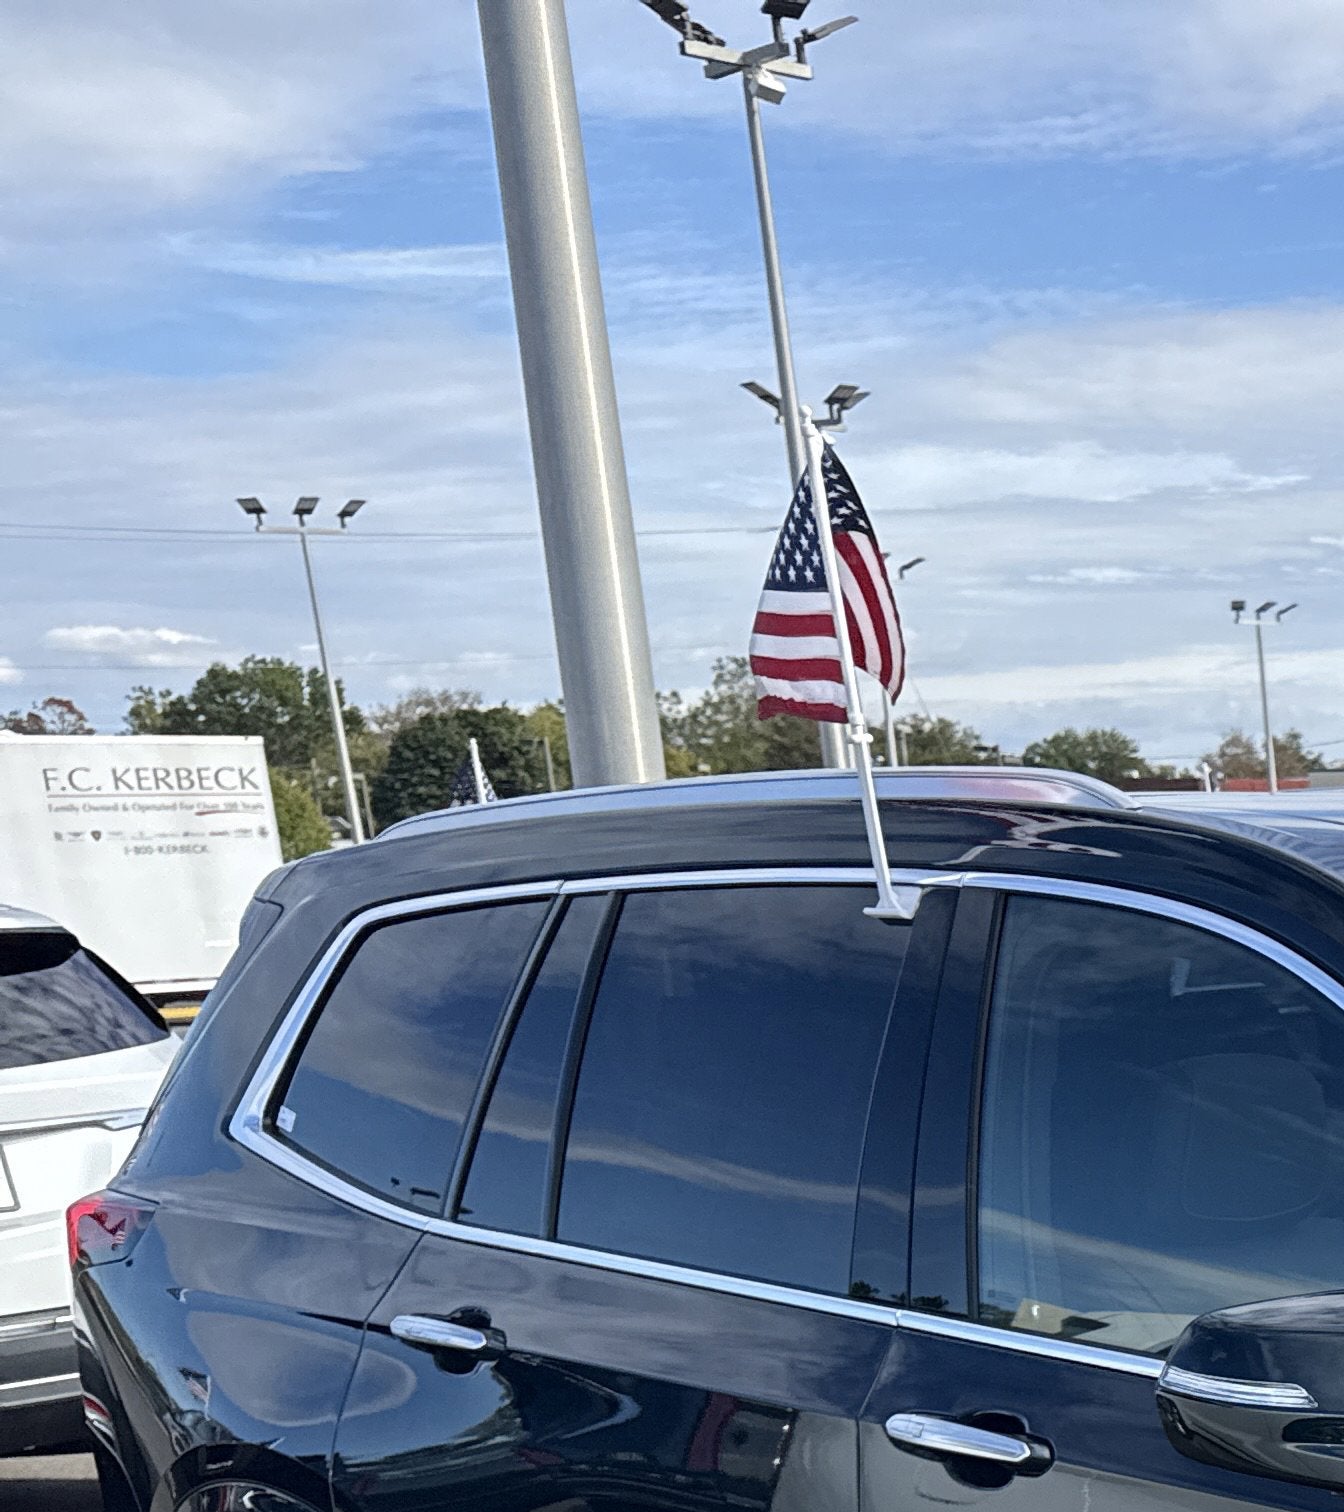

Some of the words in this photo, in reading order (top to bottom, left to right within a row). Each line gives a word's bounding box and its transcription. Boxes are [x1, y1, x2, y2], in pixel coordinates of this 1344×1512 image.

[42, 767, 102, 792] F.C.
[111, 766, 261, 791] KERBECK
[82, 802, 119, 812] Owned
[132, 801, 177, 813] Operated
